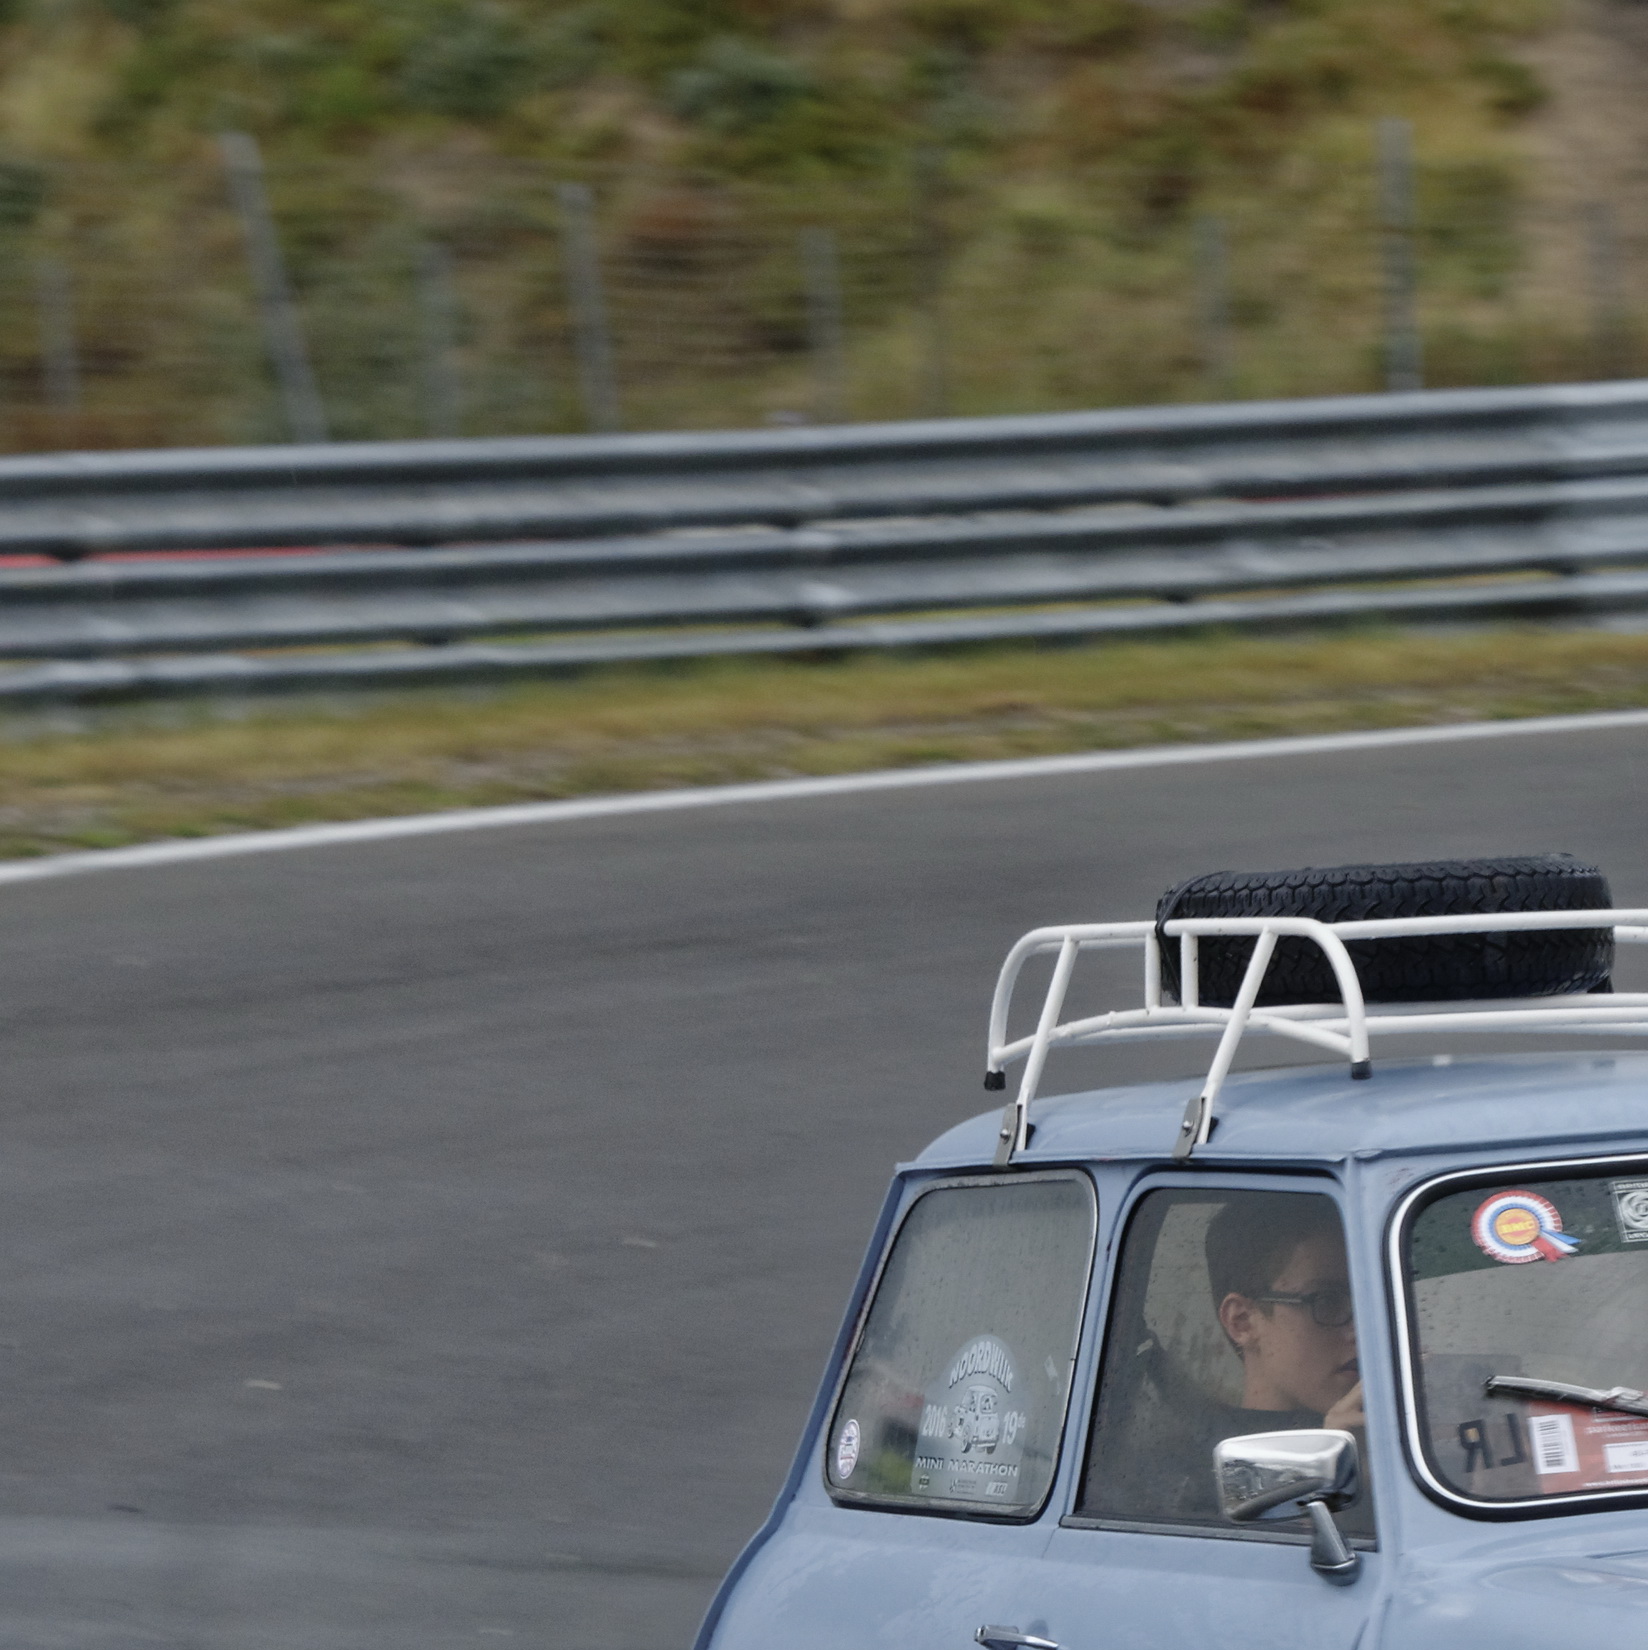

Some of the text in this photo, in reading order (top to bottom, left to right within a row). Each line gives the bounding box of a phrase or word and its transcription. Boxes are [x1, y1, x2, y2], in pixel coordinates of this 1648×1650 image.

[921, 1404, 948, 1438] 2016
[915, 1457, 1018, 1477] MINI MARATHON
